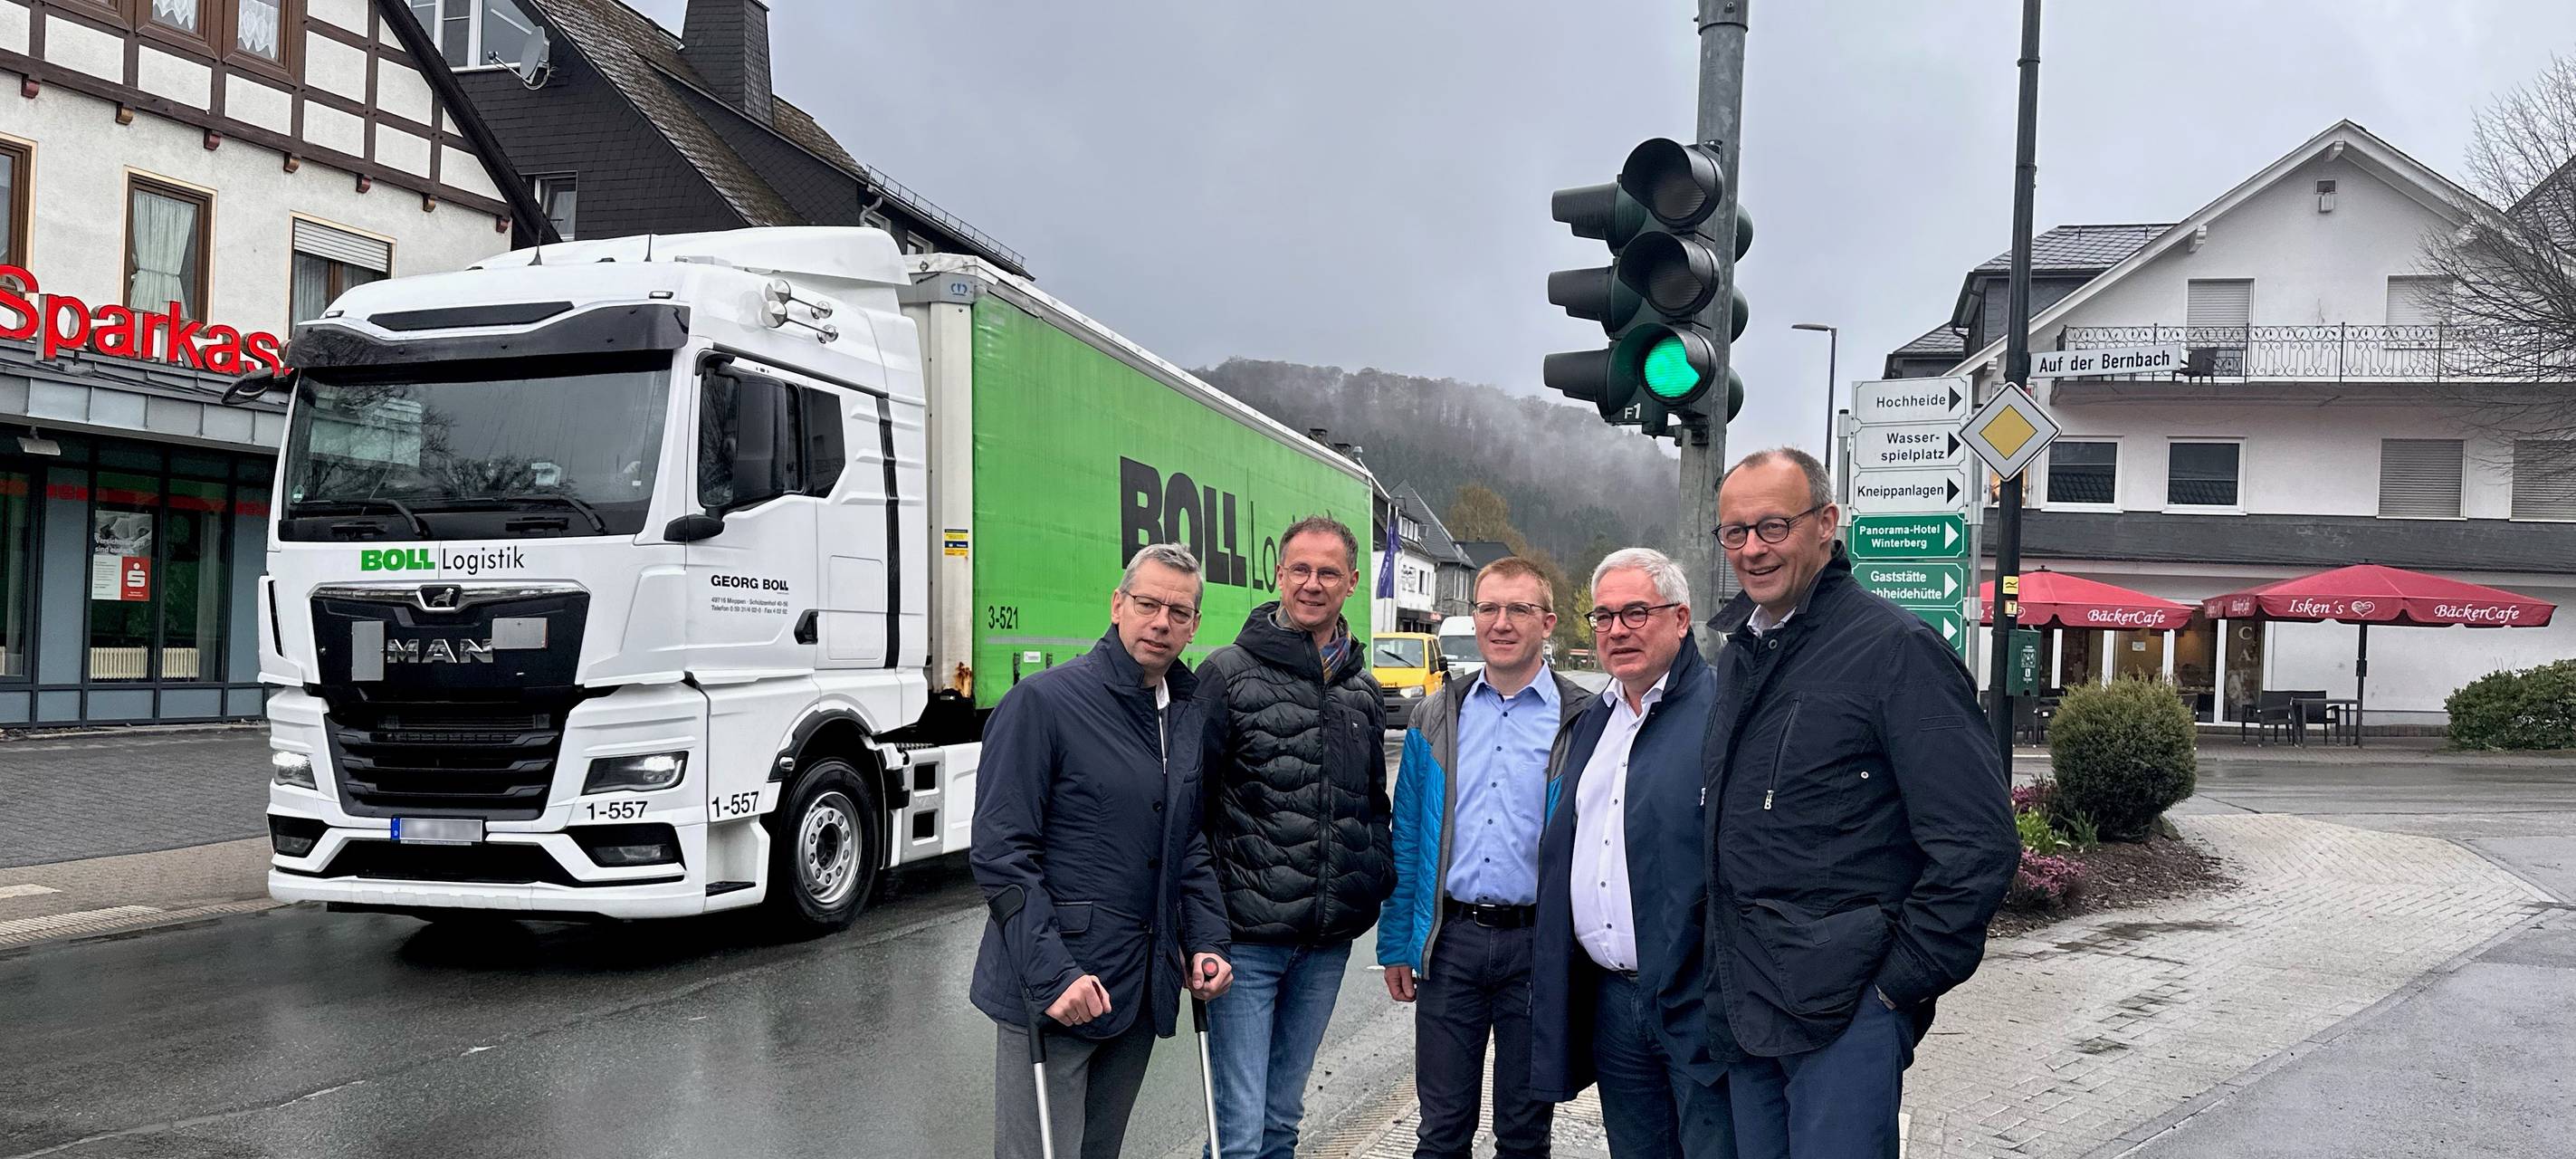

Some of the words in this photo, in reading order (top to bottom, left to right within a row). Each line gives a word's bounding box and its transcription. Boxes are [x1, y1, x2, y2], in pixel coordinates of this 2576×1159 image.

[0, 263, 295, 378] Sparkas
[2039, 357, 2063, 372] Auf
[2071, 356, 2094, 371] der
[2102, 350, 2170, 369] Bernbach
[1876, 394, 1946, 407] Hochheide
[1625, 403, 1640, 418] F1
[1887, 433, 1940, 444] Wasser-
[1881, 449, 1944, 463] spielplatz
[1857, 484, 1944, 499] Kneippanlagen
[1120, 455, 1247, 588] BOLL
[1859, 524, 1941, 535] Panorama-Hotel
[1871, 539, 1927, 550] Winterberg
[360, 549, 435, 571] BOLL
[443, 545, 525, 575] Logistik
[711, 574, 758, 589] GEORG
[763, 579, 788, 590] BOLL
[1871, 570, 1927, 582] Gaststätte
[988, 606, 1018, 629] 3-521
[2087, 608, 2165, 627] BäckerCafe
[2434, 604, 2519, 623] BäckerCafe
[387, 639, 493, 663] MAN
[587, 801, 648, 819] 1-557
[711, 791, 759, 818] 1-557
